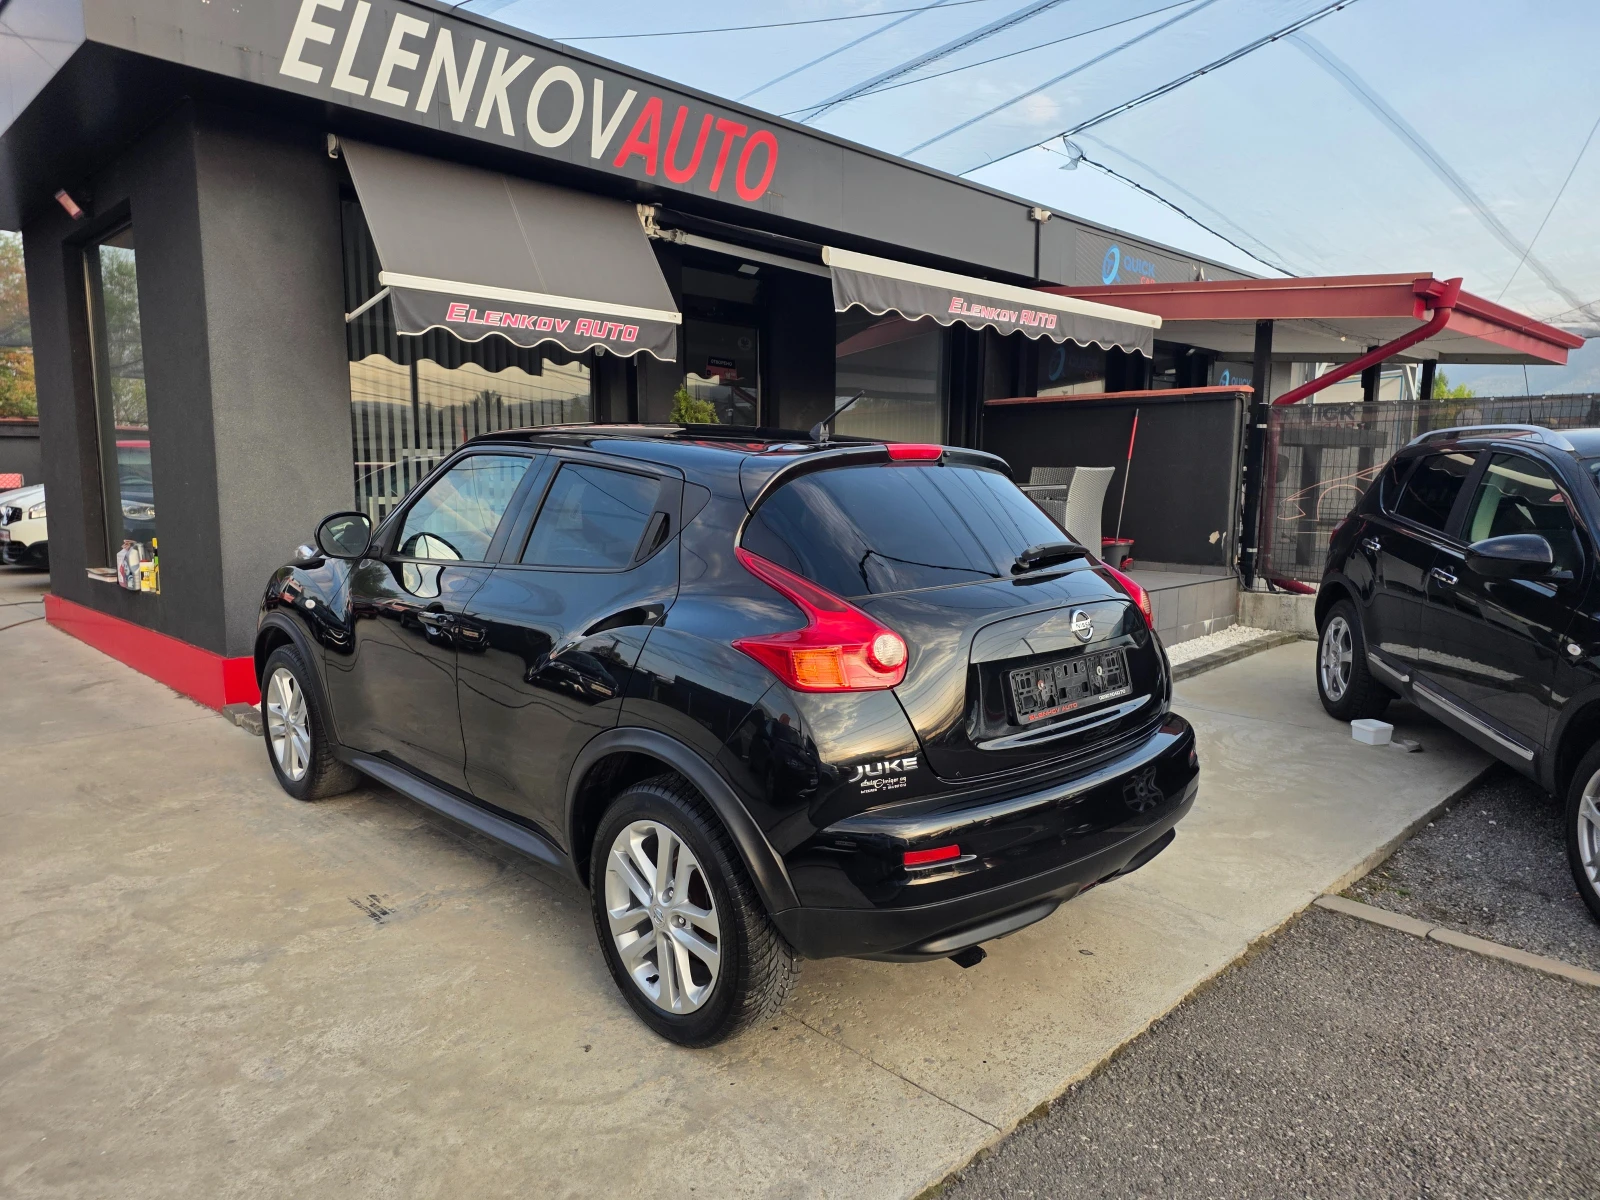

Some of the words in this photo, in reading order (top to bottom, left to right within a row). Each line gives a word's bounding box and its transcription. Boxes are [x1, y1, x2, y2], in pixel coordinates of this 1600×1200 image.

[1123, 255, 1156, 278] QUICK
[445, 302, 571, 332] ELENKOV
[574, 317, 640, 343] AUTO
[948, 296, 1019, 323] ELENKOV
[1020, 309, 1058, 329] AUTO
[848, 756, 919, 784] JUKE
